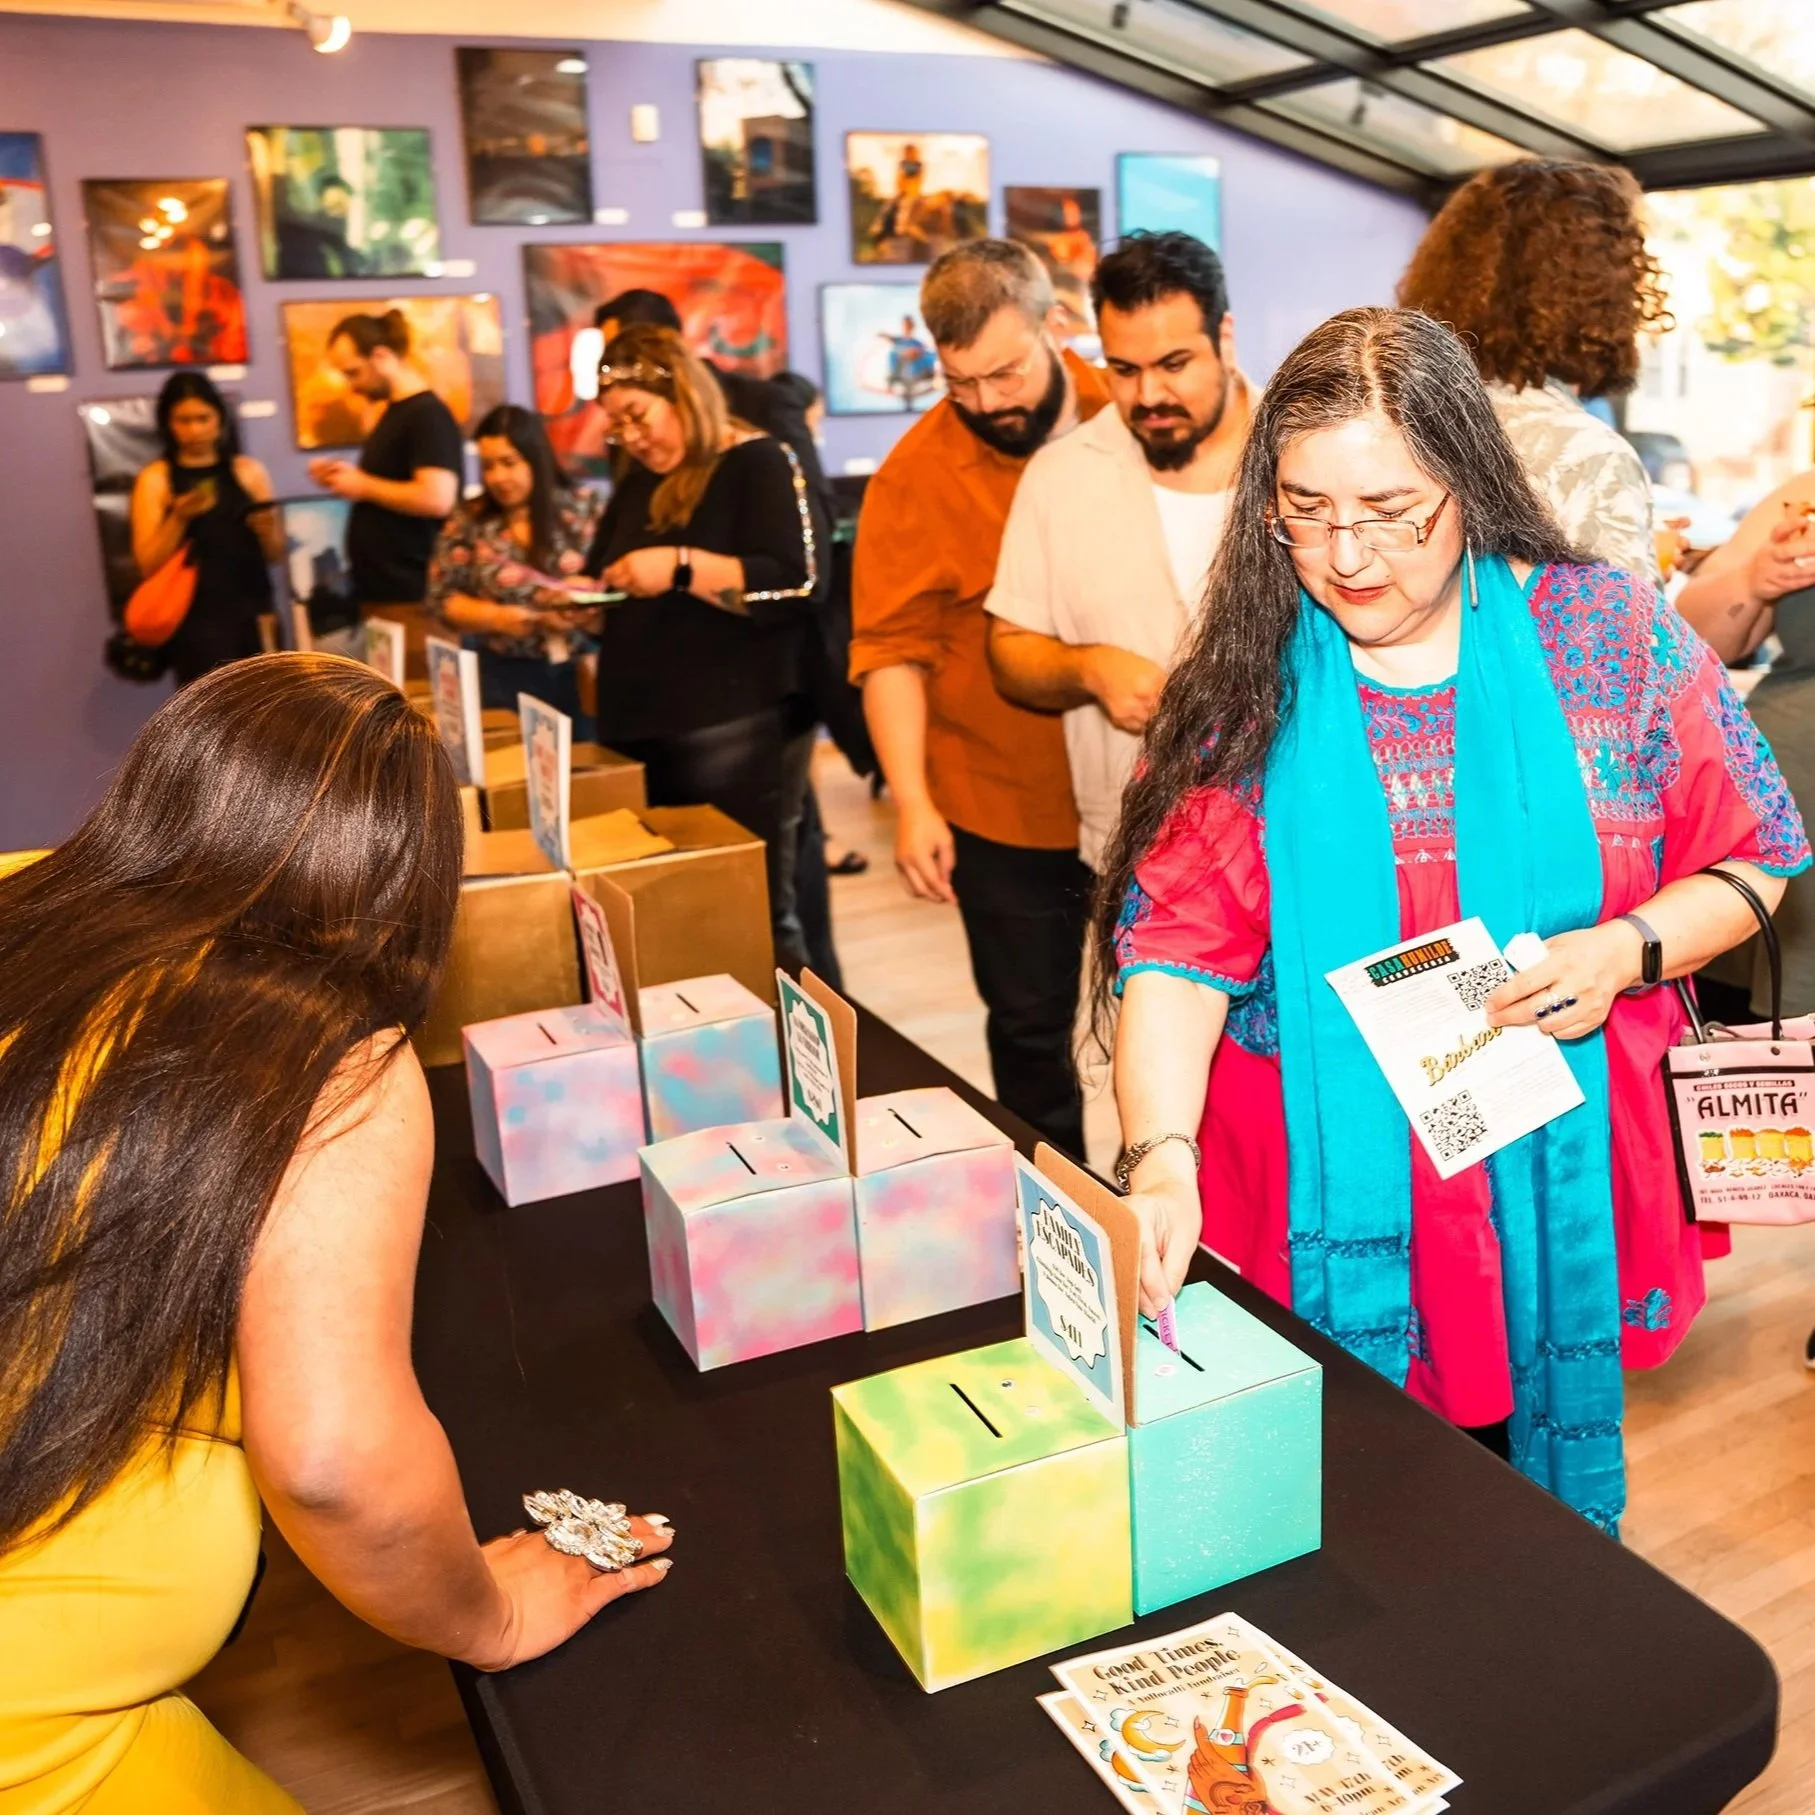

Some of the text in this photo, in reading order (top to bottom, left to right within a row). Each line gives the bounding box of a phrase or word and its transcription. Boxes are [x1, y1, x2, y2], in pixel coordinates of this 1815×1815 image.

[1043, 1209, 1081, 1256] FAMILY
[1036, 1220, 1095, 1287] ESCAPADES
[1093, 1656, 1149, 1680] Good
[1109, 1649, 1241, 1695] Kind People
[1304, 1772, 1372, 1804] MAY 17th
[1320, 1785, 1376, 1813] 6-10pm
